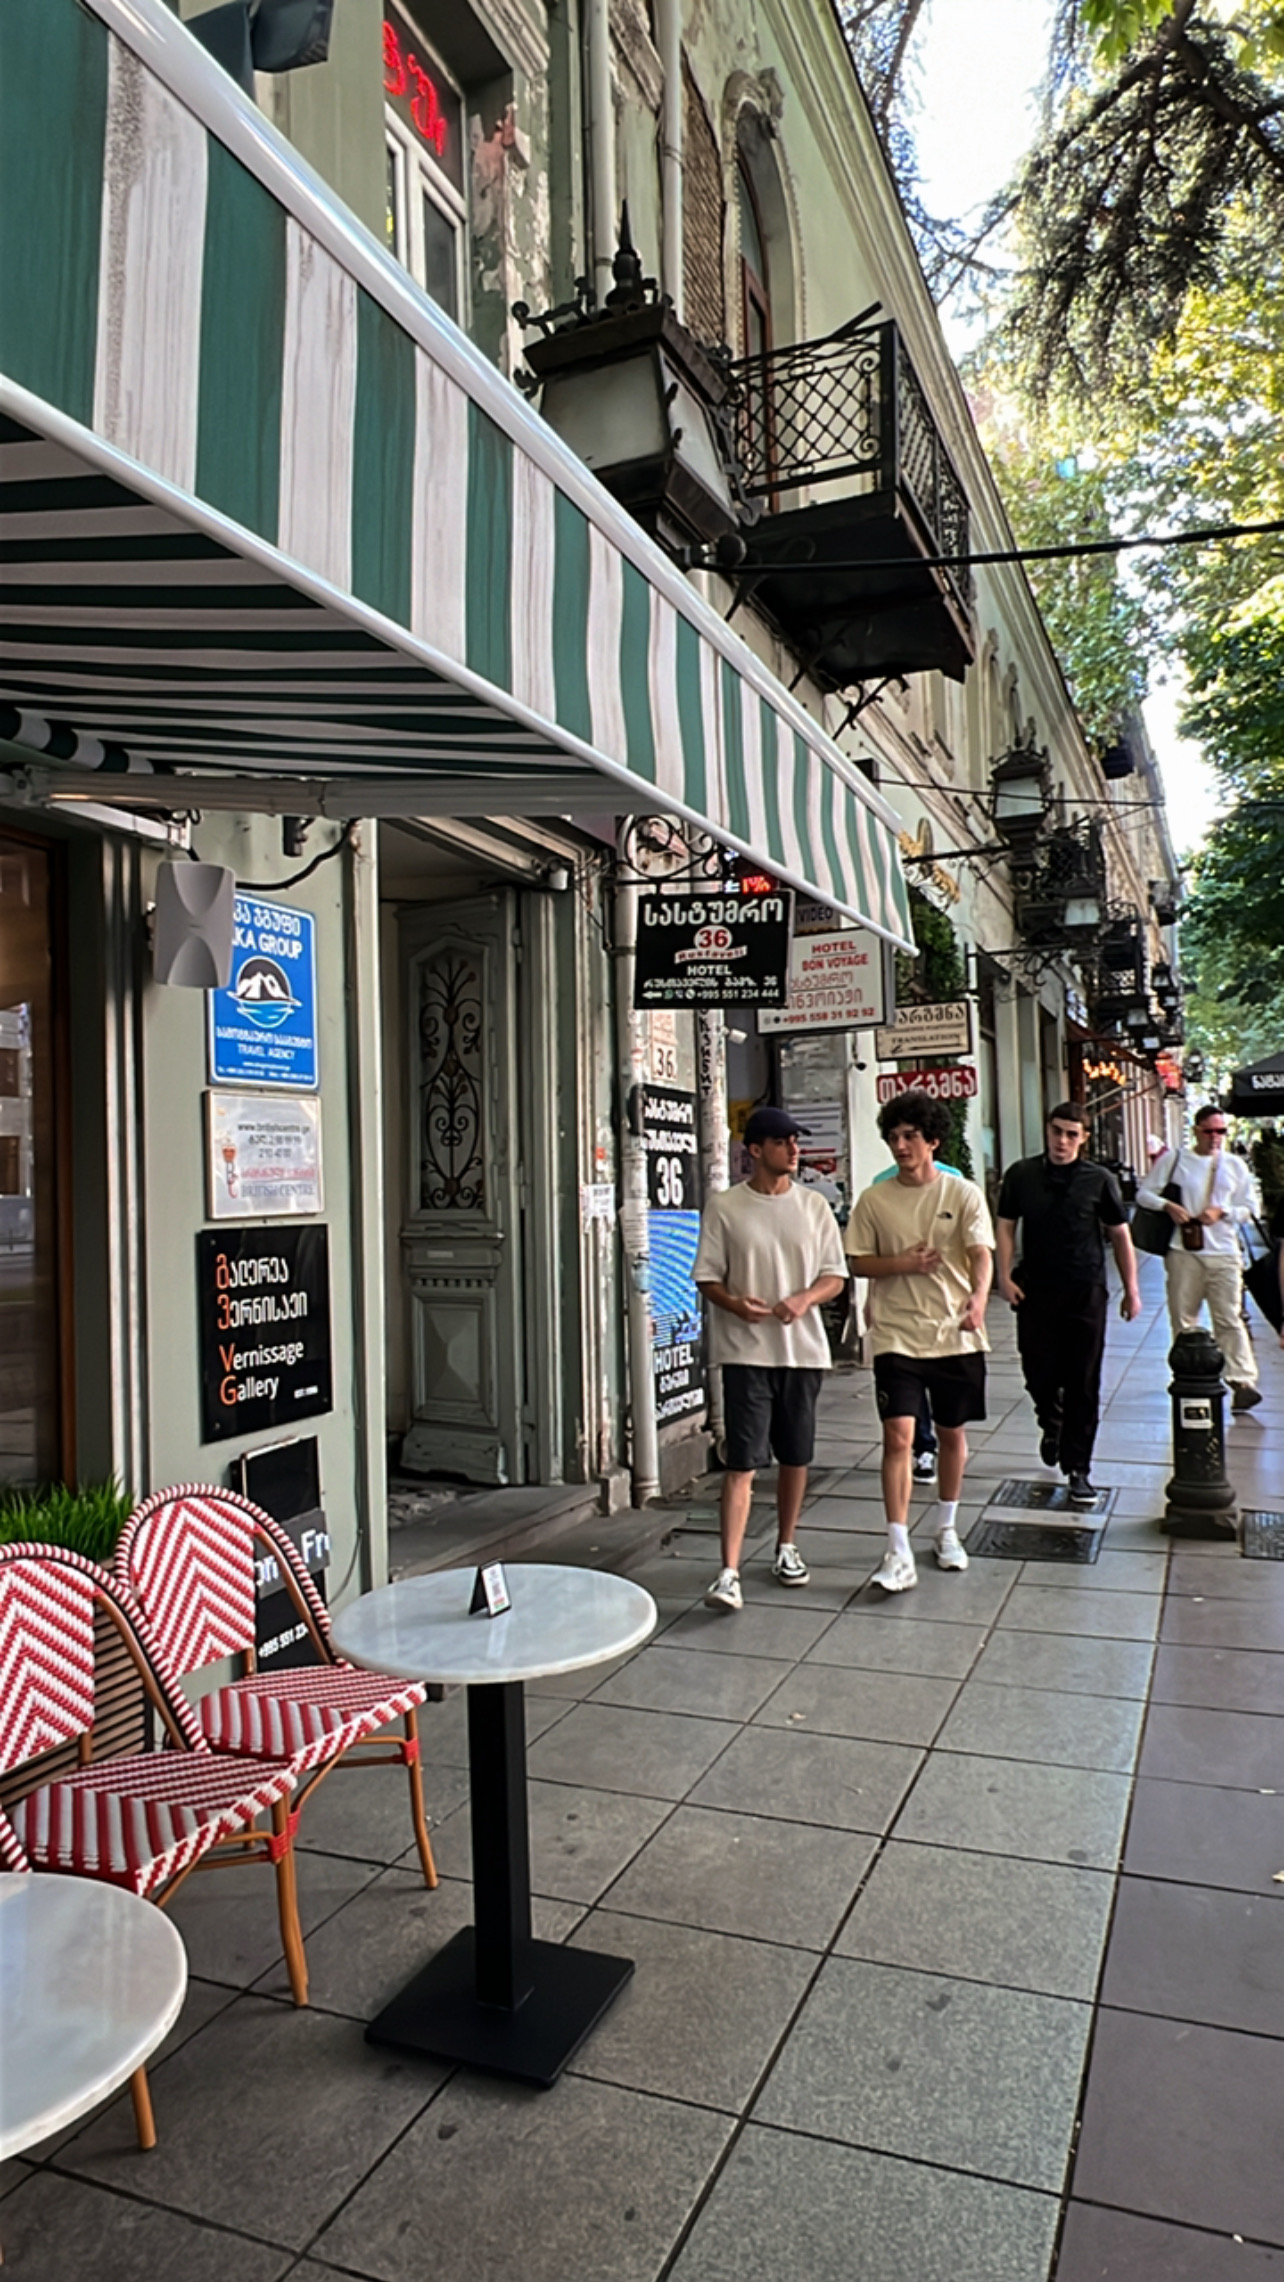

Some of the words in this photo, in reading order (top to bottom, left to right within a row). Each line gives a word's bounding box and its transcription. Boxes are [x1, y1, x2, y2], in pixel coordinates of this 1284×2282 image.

[644, 898, 783, 926] სასტუმრო
[258, 932, 303, 960] GROUP
[699, 930, 728, 948] 36
[812, 940, 857, 954] HOTEL
[687, 964, 732, 976] HOTEL
[802, 959, 825, 971] BON
[827, 953, 868, 969] VOYAGE
[697, 989, 720, 1000] +995
[722, 989, 739, 999] 551
[741, 988, 759, 999] 234
[762, 988, 780, 998] 444
[891, 1032, 961, 1044] TRANSLATION
[656, 1047, 675, 1078] 36
[656, 1156, 685, 1206] 36
[216, 1253, 290, 1290] გალერეა
[218, 1341, 305, 1373] Vernissage
[653, 1343, 695, 1375] HOTEL
[220, 1374, 279, 1405] Gallery
